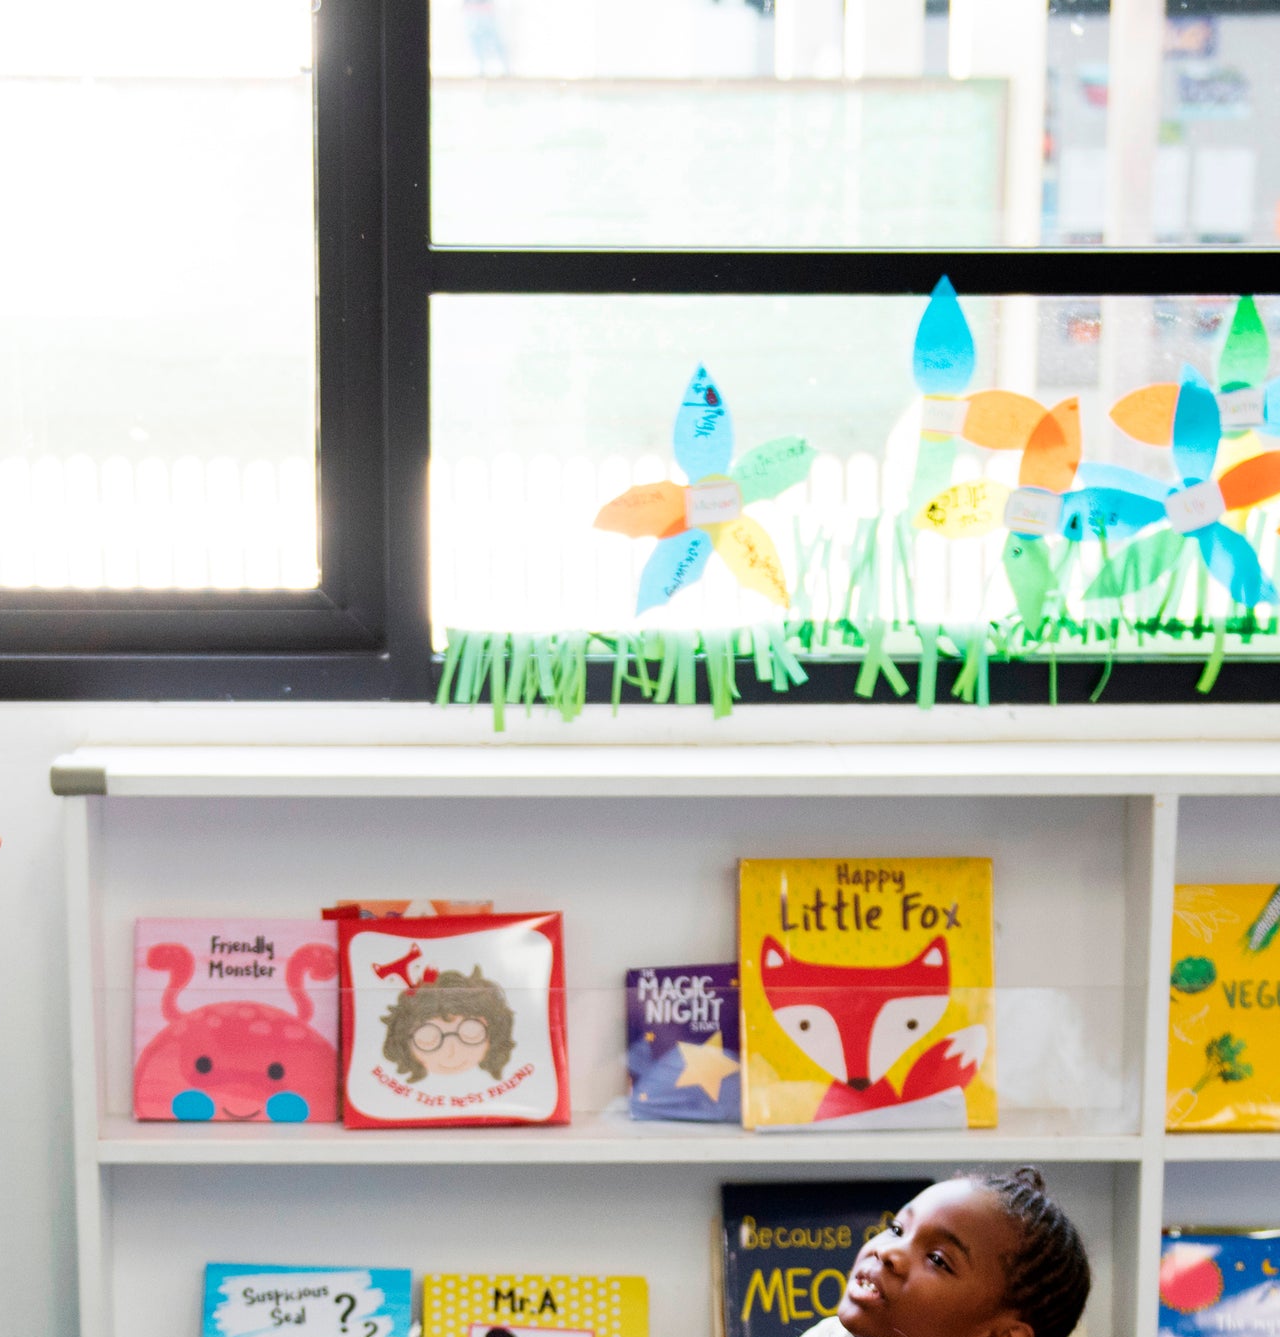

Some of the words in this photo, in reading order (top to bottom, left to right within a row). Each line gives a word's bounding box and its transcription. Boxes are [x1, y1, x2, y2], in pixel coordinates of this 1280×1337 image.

[837, 864, 905, 893] Happy
[780, 889, 881, 931] Little
[901, 892, 961, 931] Fox
[211, 935, 274, 960] Friendly
[209, 961, 276, 979] Monster
[638, 975, 716, 1001] MAGIC
[645, 997, 724, 1024] NIGHT
[372, 1065, 413, 1097] BOBBY
[417, 1091, 445, 1106] THE
[450, 1092, 484, 1107] BEST
[487, 1063, 535, 1098] FRIEND
[740, 1215, 852, 1249] Because
[242, 1286, 328, 1306] Suspicious
[493, 1288, 558, 1315] Mr.A
[741, 1268, 848, 1324] MEO
[271, 1305, 306, 1327] Seal
[1216, 1313, 1244, 1331] The
